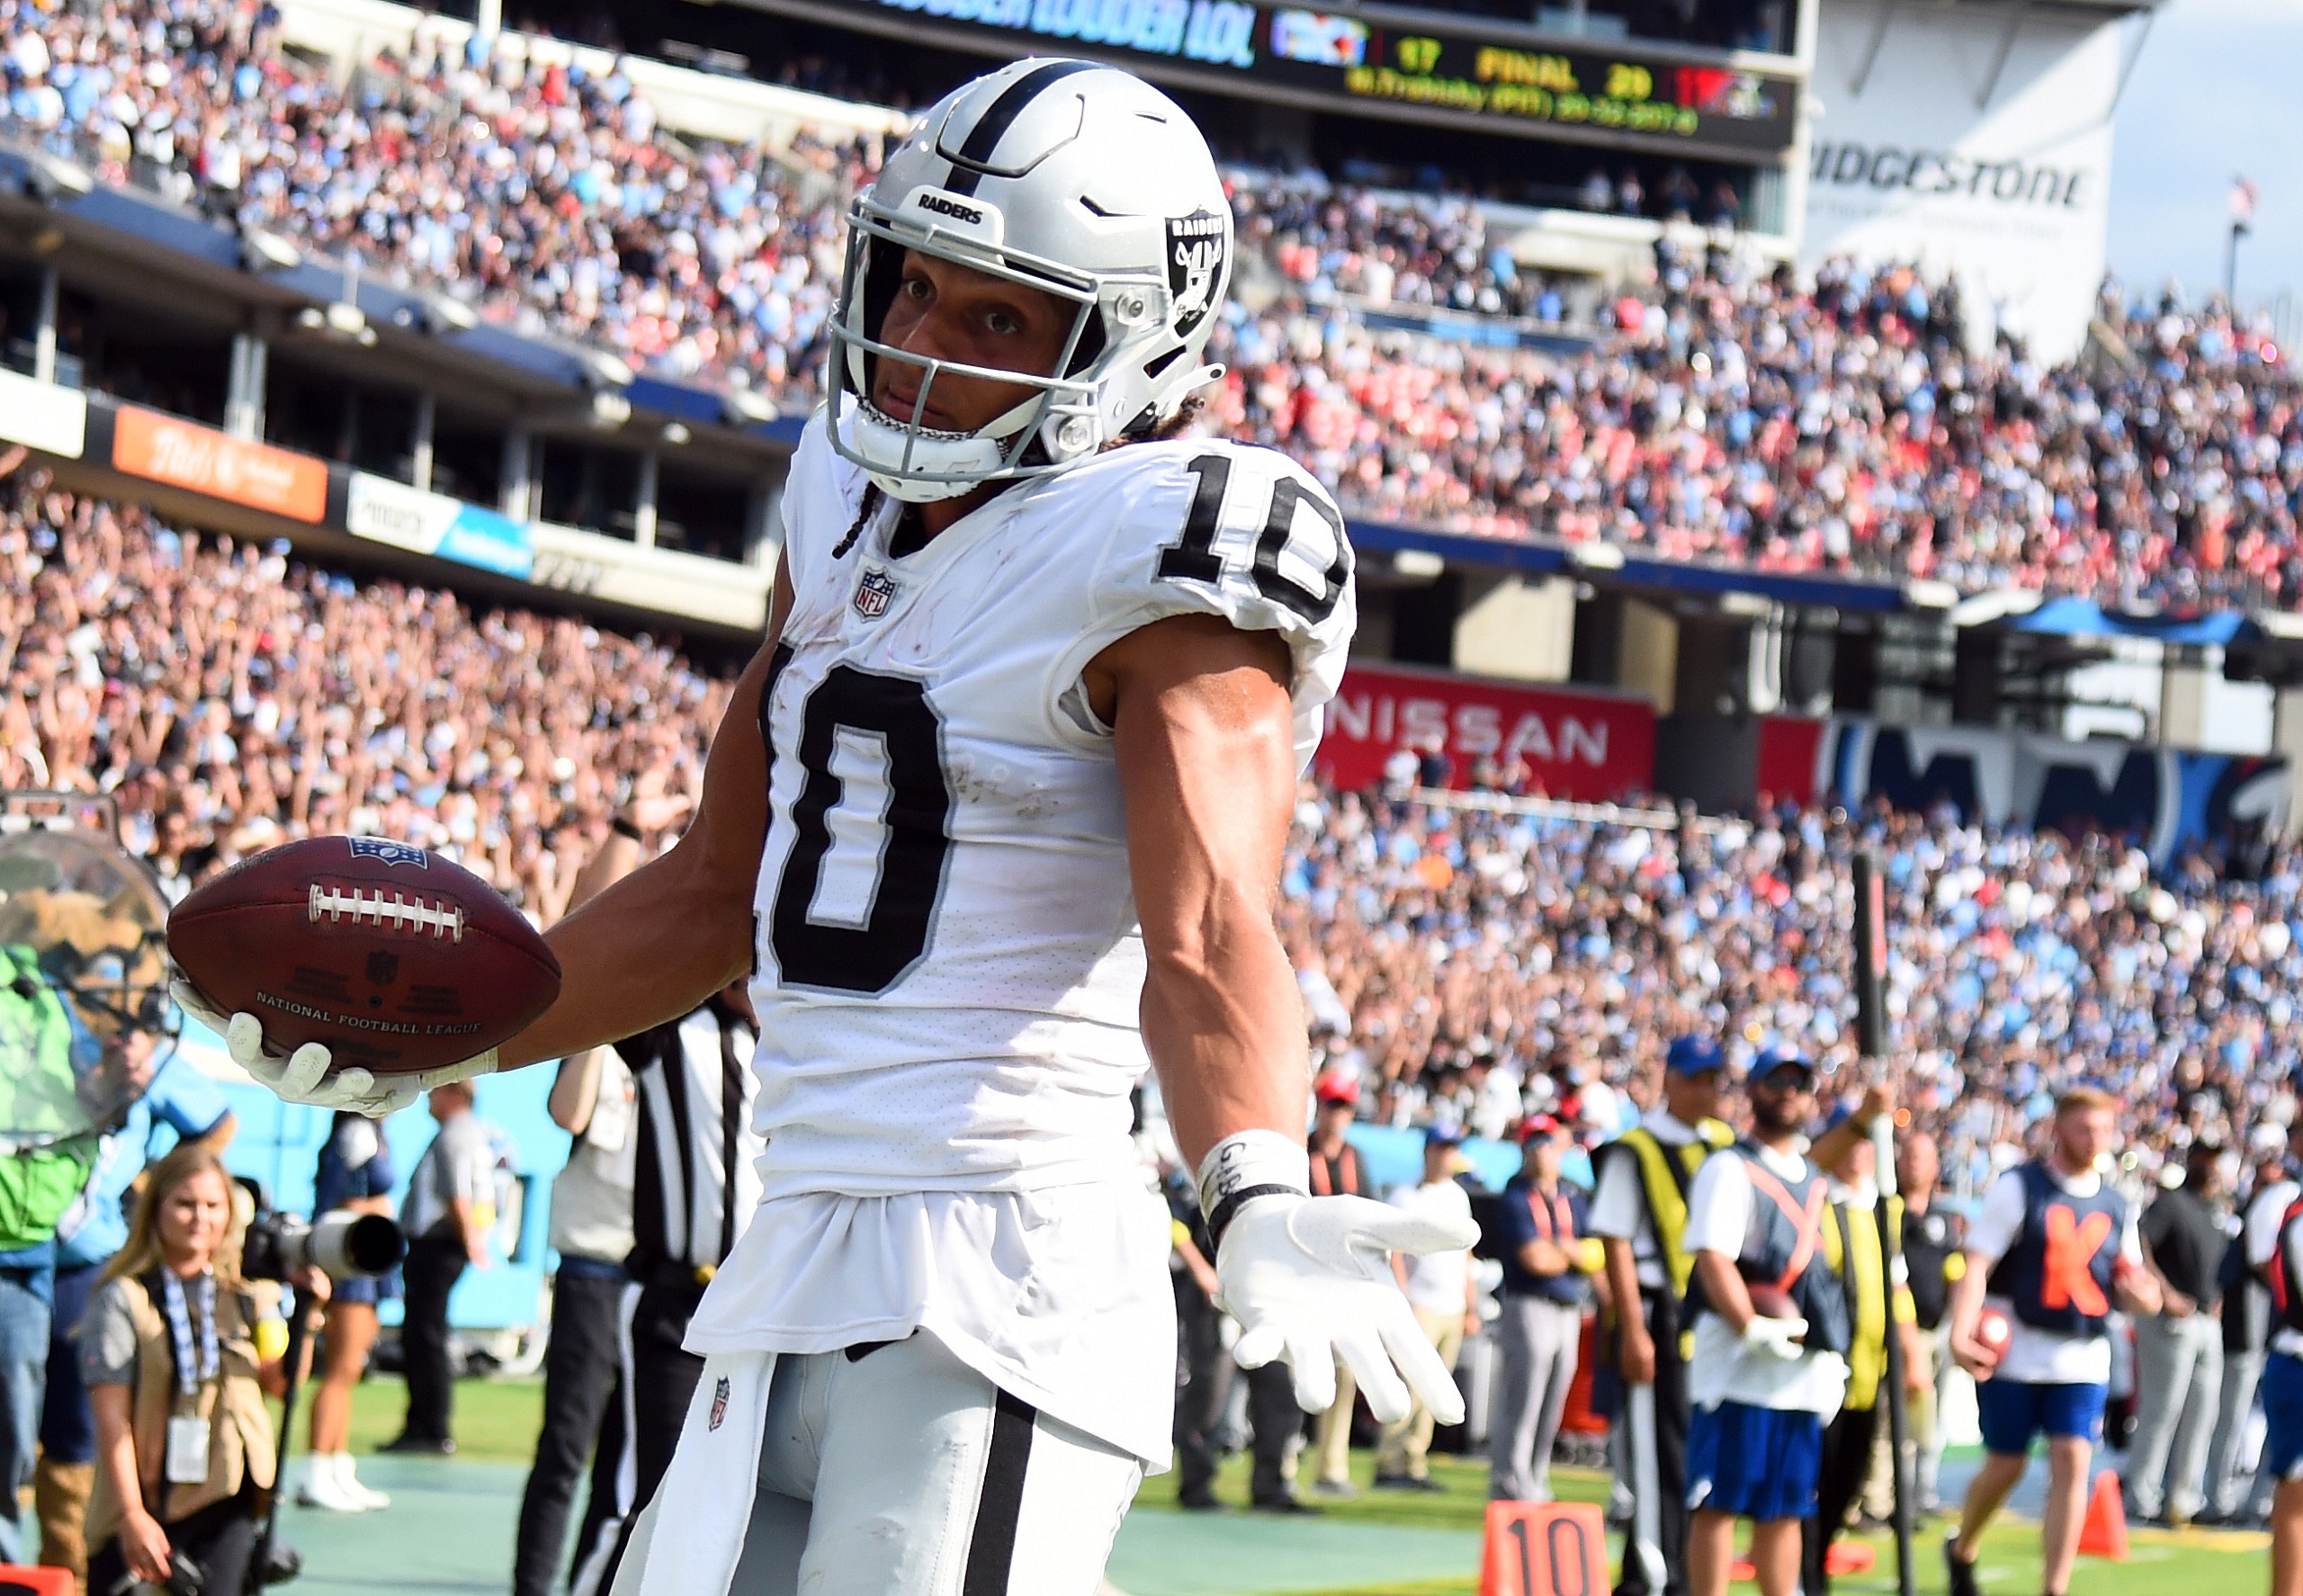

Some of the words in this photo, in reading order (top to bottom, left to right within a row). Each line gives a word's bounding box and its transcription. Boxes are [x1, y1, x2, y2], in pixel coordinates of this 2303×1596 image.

[1475, 46, 1579, 92] FINAL
[918, 193, 984, 225] RAIDERS
[1171, 216, 1223, 237] RAIDERS
[1155, 454, 1350, 625] 10
[857, 587, 883, 613] NFL
[1324, 691, 1610, 768] NISSAN
[256, 991, 332, 1023] NATIONAL
[338, 1014, 419, 1035] FOOTBALL
[425, 1022, 482, 1036] LEAGUE
[2040, 1203, 2114, 1317] K
[1506, 1517, 1591, 1596] 10
